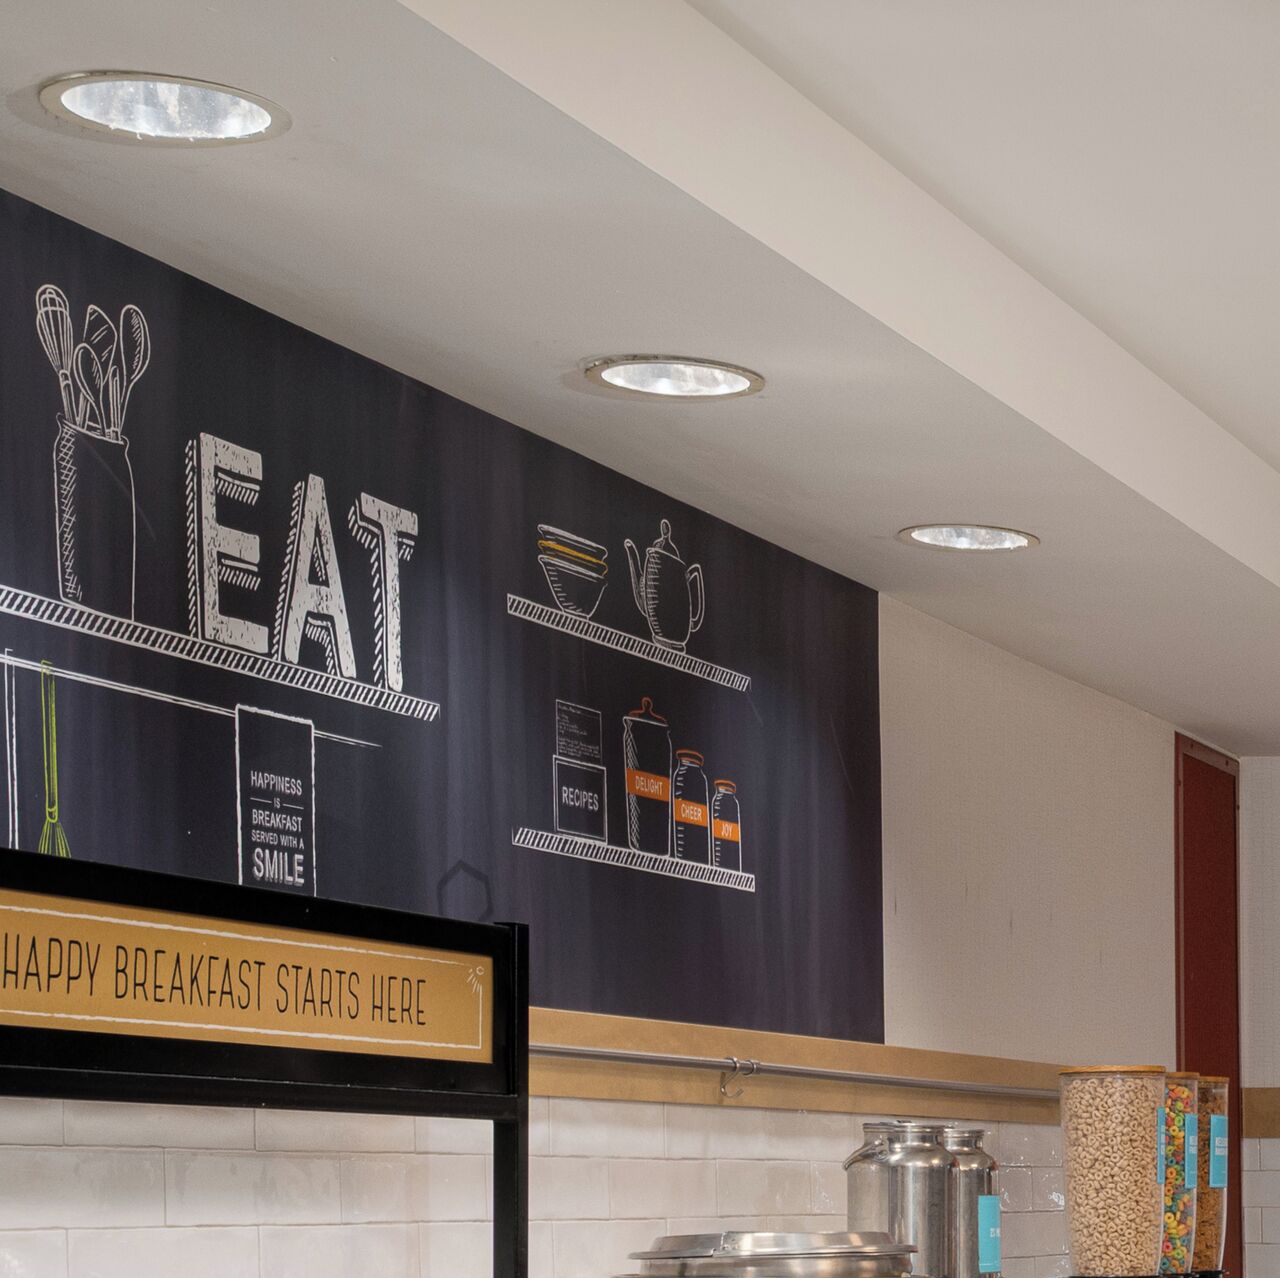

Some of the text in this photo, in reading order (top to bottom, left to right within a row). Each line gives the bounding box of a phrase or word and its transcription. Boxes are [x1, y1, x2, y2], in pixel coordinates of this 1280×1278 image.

[185, 432, 419, 694] EAT
[251, 771, 302, 796] HAPPINESS
[635, 775, 664, 796] DELIGHT
[273, 798, 281, 808] IS
[562, 786, 599, 812] RECIPES
[252, 808, 303, 832] BREAKFAST
[680, 803, 702, 822] CHEER
[251, 830, 304, 849] SERVED WITH A
[720, 823, 733, 838] JOY
[253, 847, 304, 886] SMILE
[2, 931, 428, 1026] HAPPY BREAKFAST STARTS HERE
